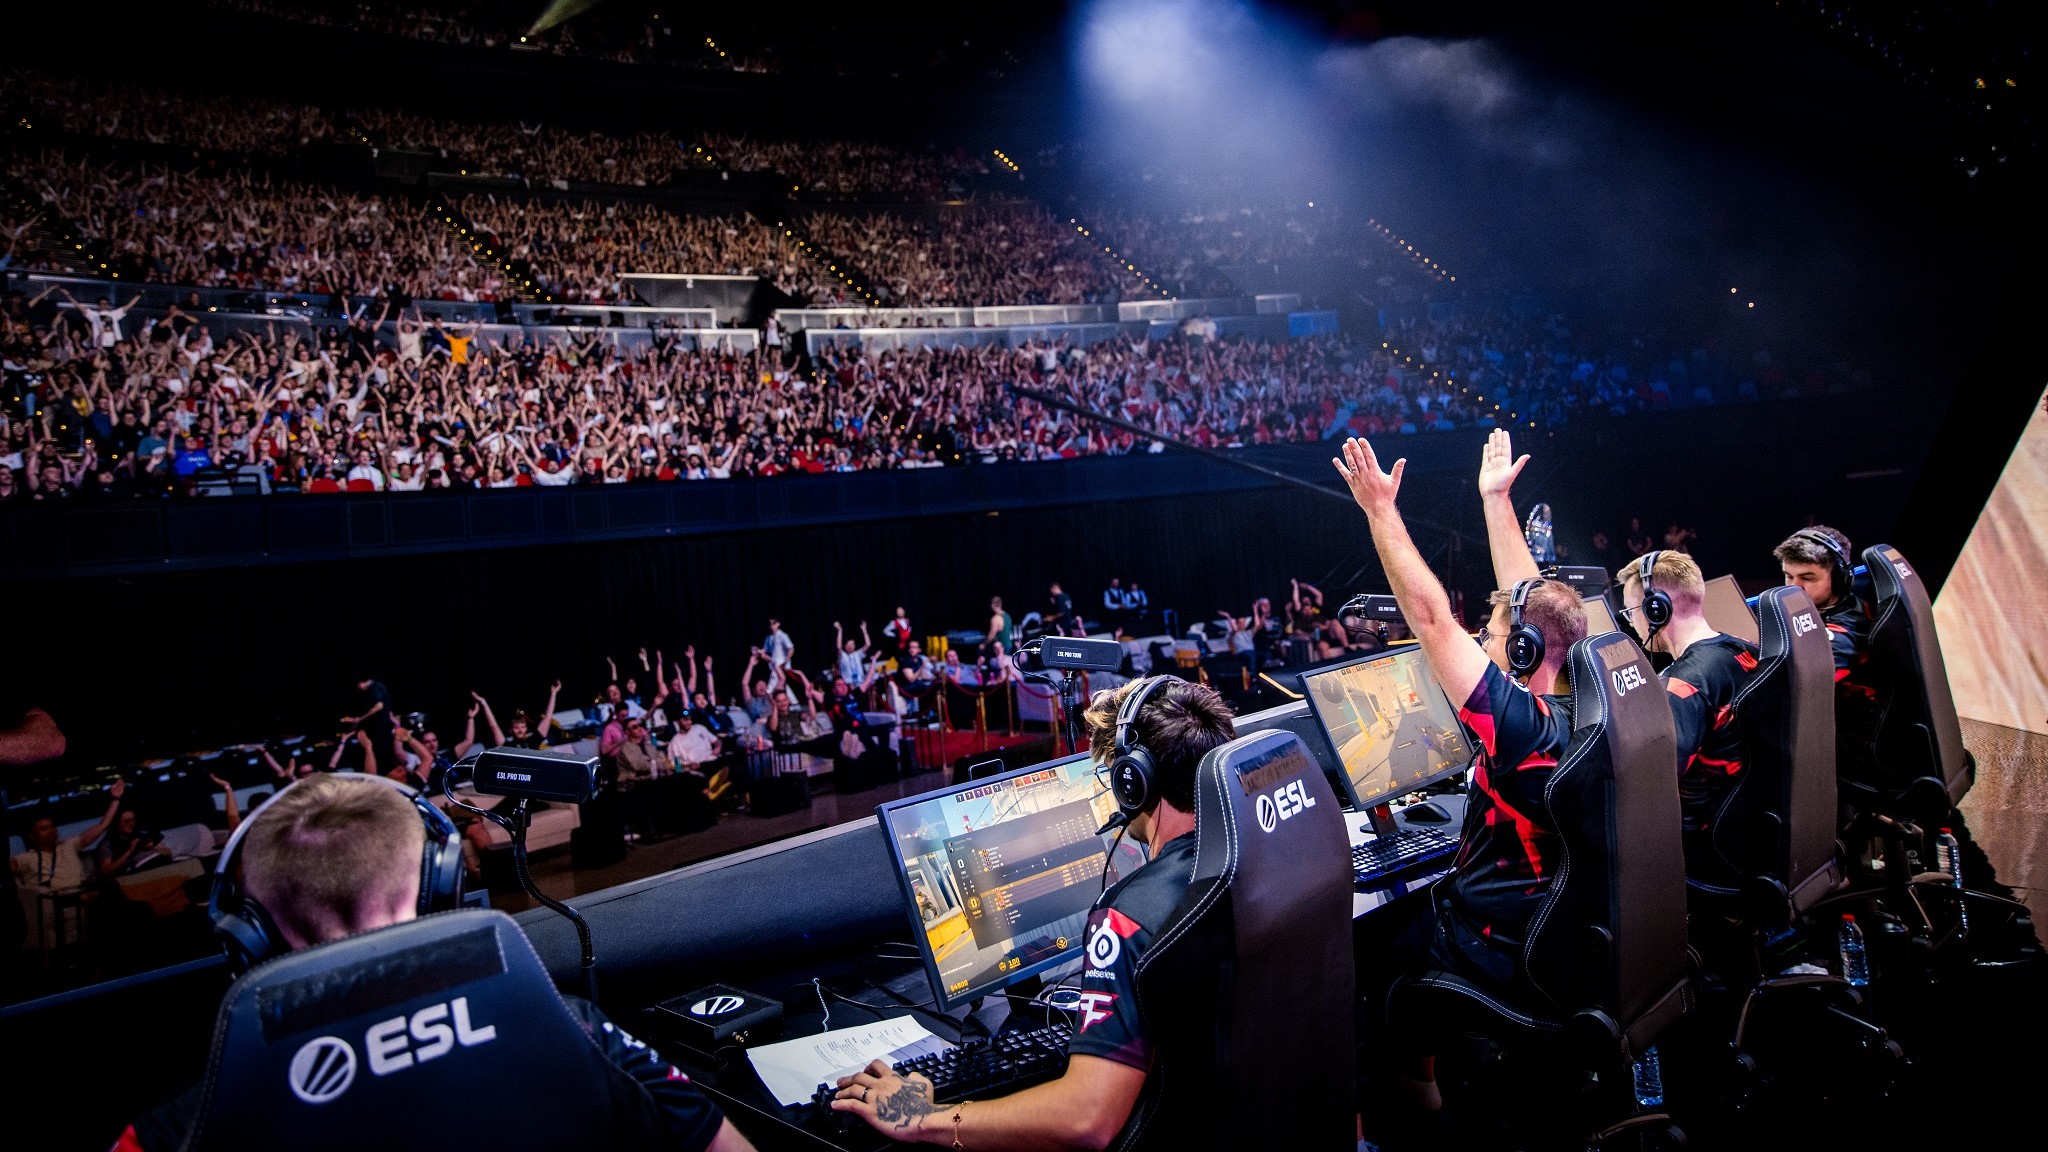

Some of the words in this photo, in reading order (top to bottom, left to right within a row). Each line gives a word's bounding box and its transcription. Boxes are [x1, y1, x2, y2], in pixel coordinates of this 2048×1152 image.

[1798, 612, 1818, 633] ESL
[1621, 664, 1647, 690] ESL
[496, 771, 506, 780] ESL
[506, 772, 518, 781] PRO
[518, 773, 532, 782] TOUR
[1273, 779, 1316, 820] ESL
[365, 996, 497, 1077] ESL
